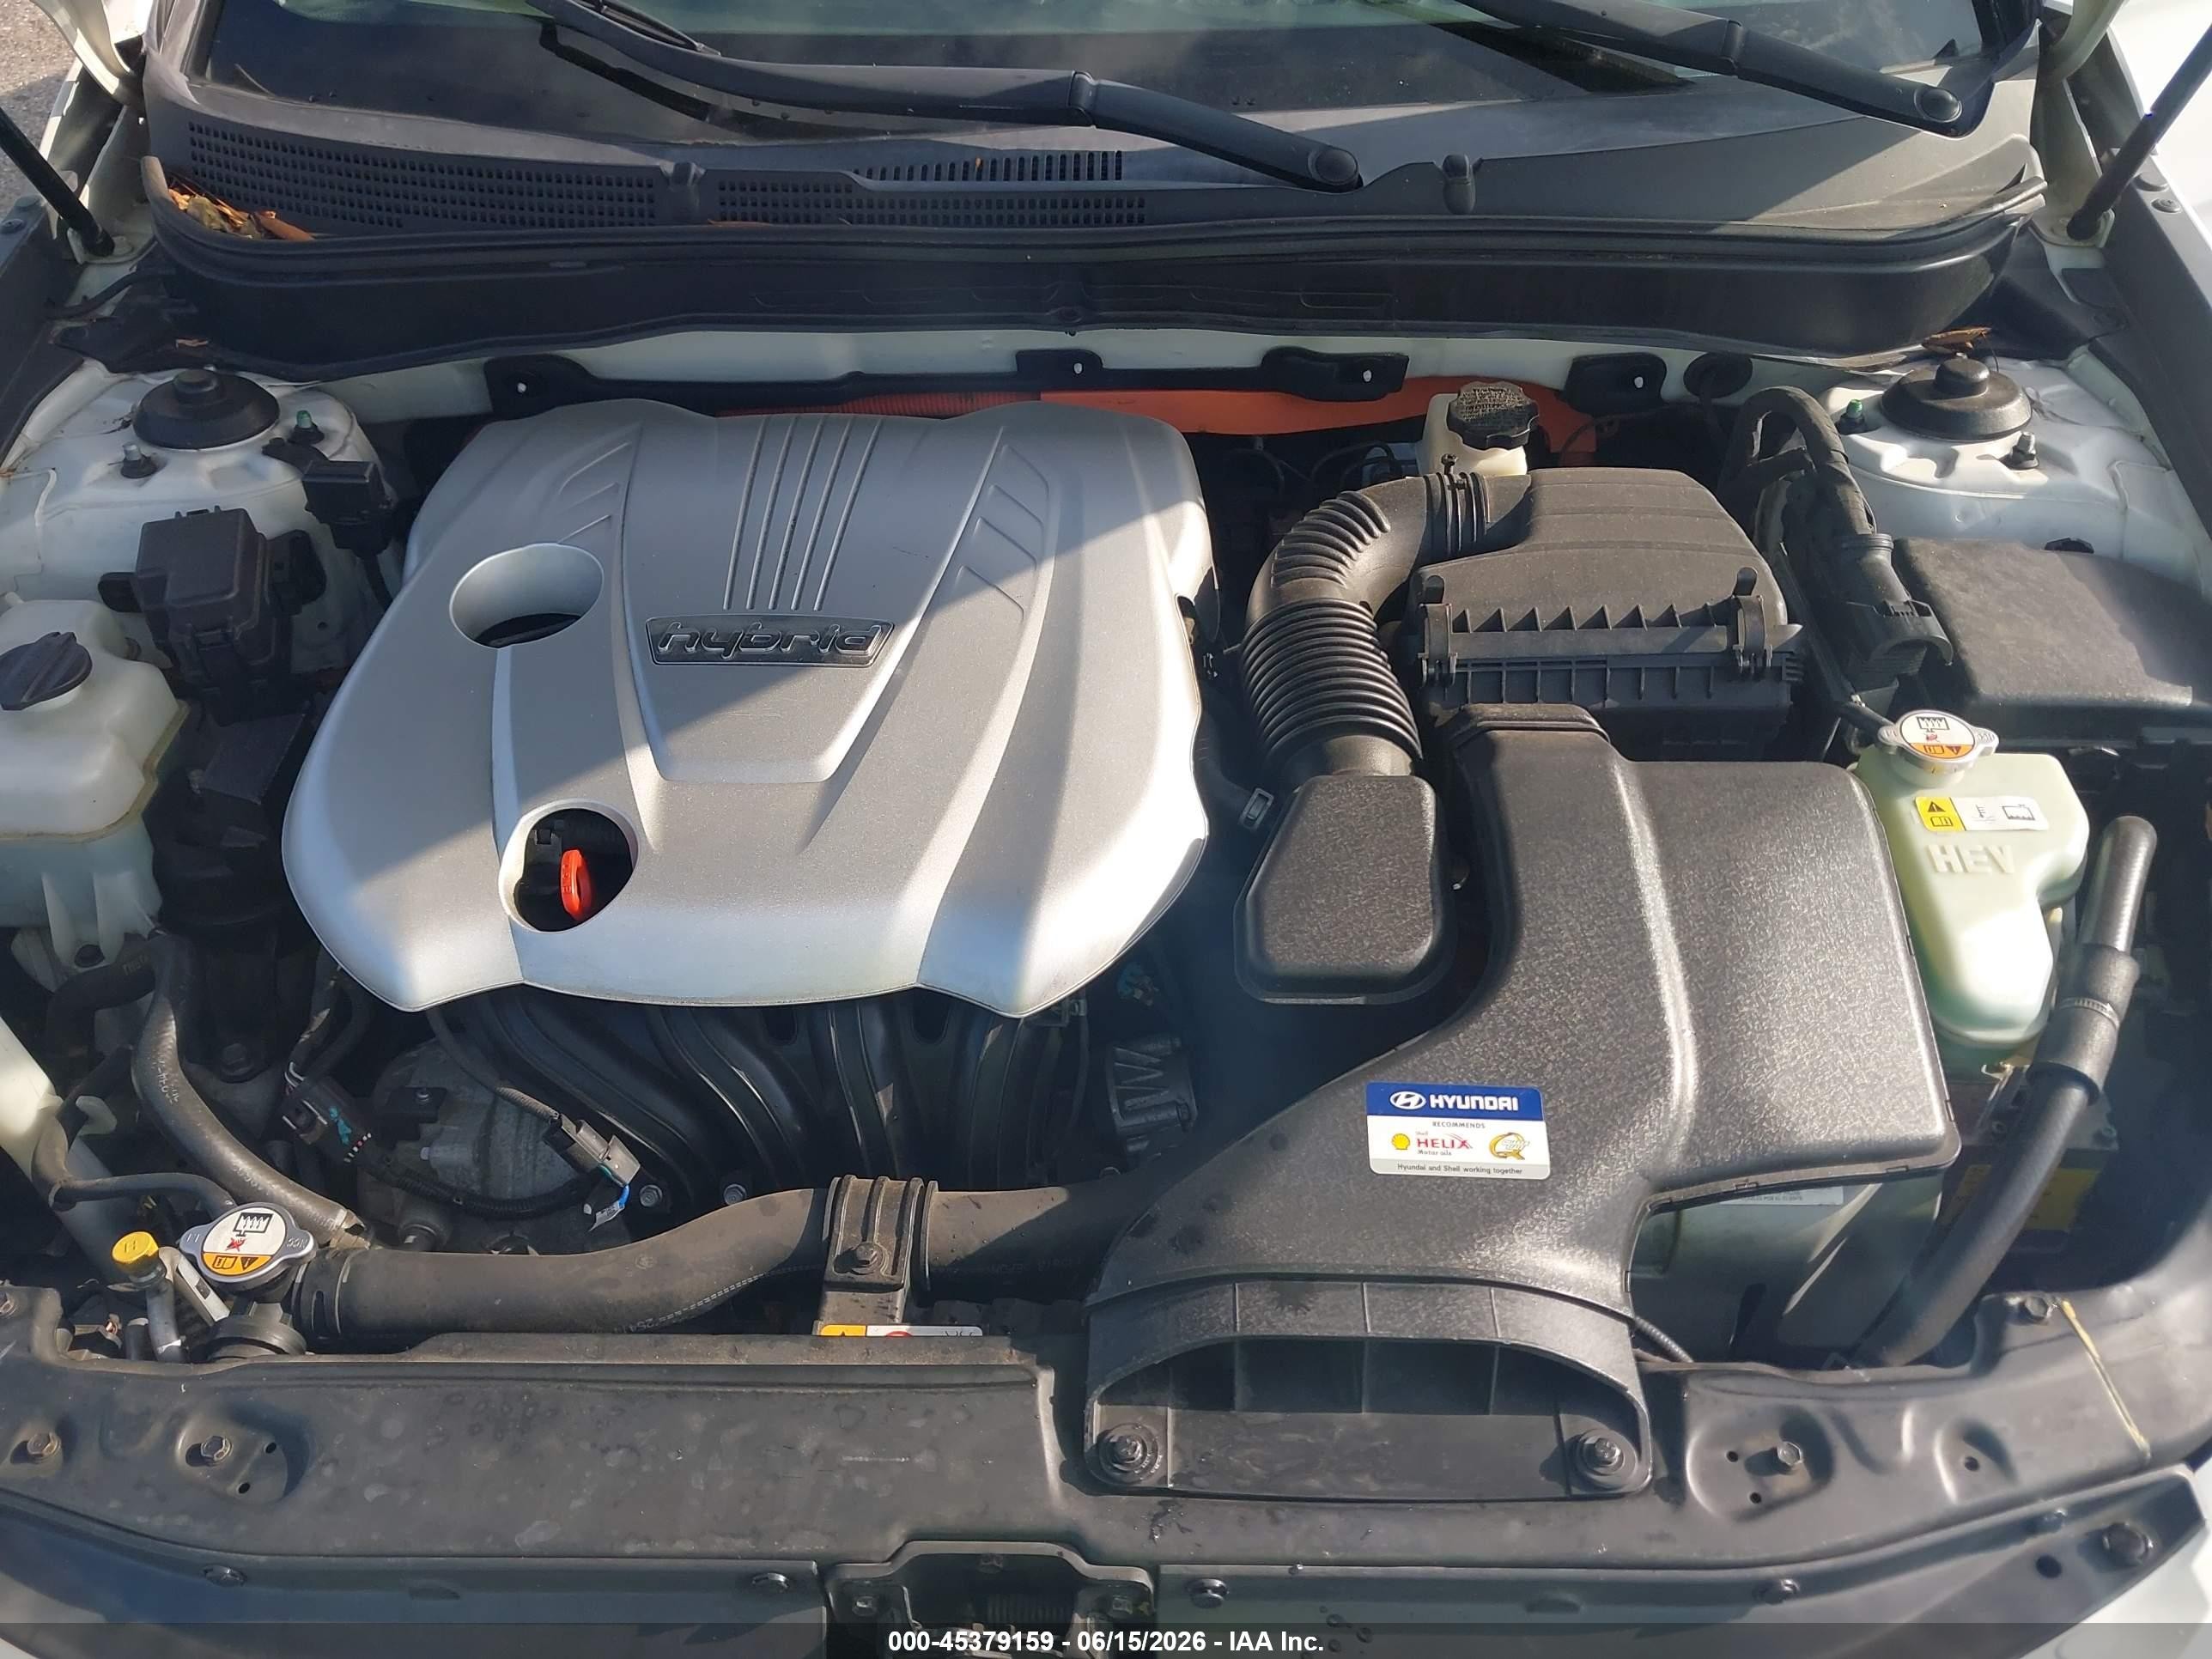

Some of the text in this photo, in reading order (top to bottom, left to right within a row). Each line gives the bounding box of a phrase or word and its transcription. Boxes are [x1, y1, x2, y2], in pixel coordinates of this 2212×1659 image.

[658, 621, 882, 659] hybrid
[1927, 844, 2015, 873] HEV
[1429, 1094, 1519, 1111] HYUNDAI
[1431, 1121, 1486, 1129] RECOMMENDS
[1417, 1138, 1471, 1149] HELIX
[1397, 1163, 1426, 1171] Hyundai
